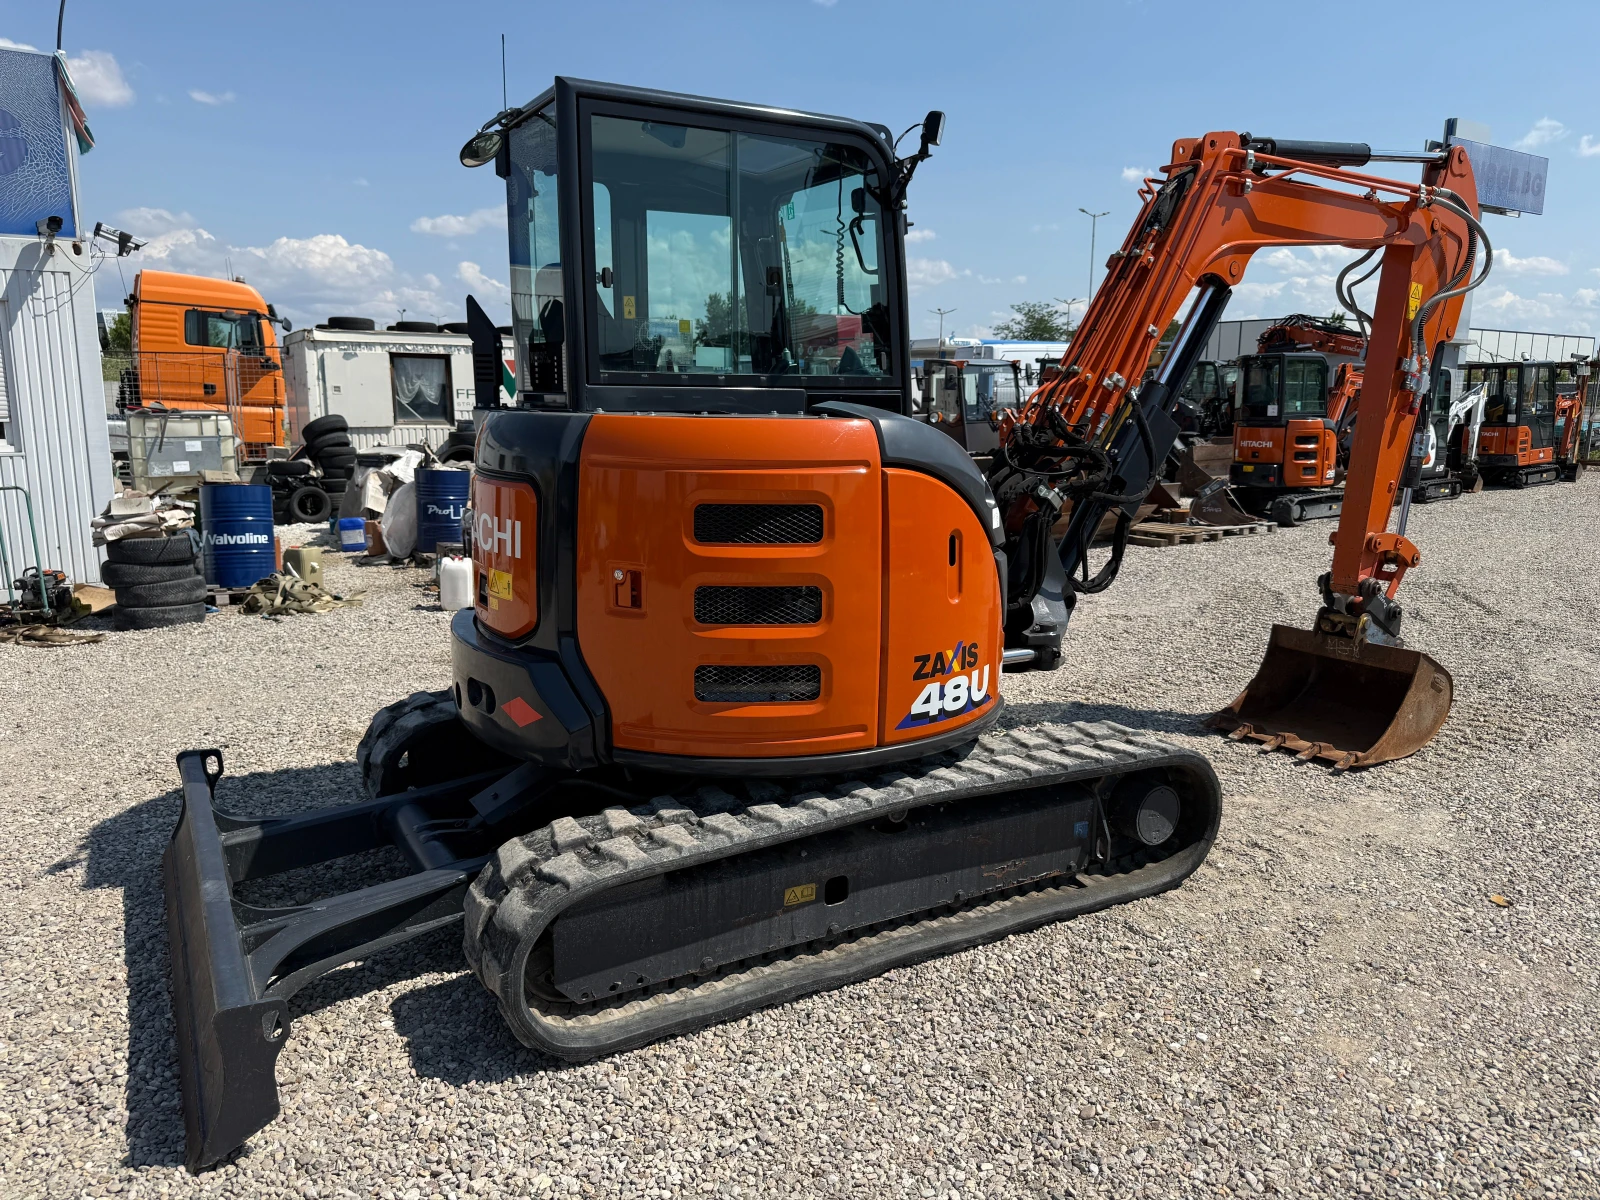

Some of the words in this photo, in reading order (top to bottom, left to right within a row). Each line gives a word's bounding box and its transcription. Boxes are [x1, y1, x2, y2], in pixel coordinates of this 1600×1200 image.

[1240, 440, 1273, 448] HITACHI
[207, 532, 270, 546] Valvoline
[912, 640, 979, 681] ZAXIS
[910, 663, 990, 721] 48U
